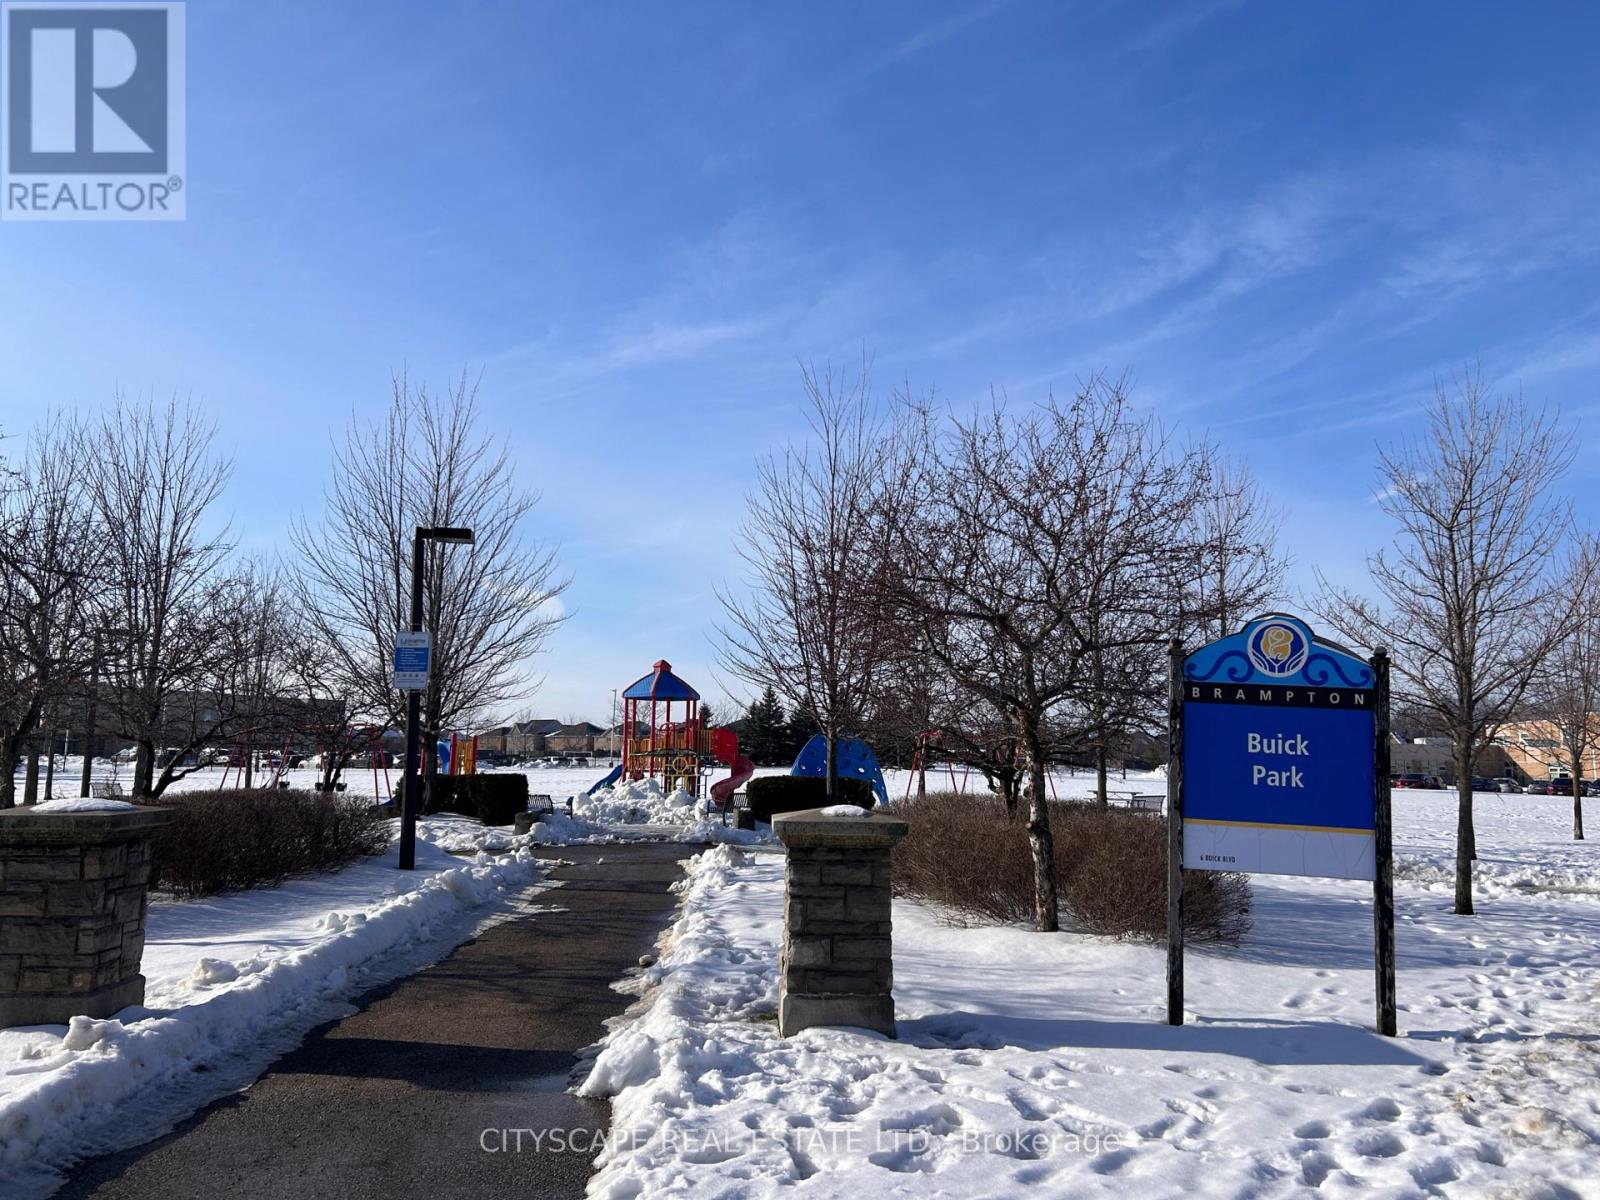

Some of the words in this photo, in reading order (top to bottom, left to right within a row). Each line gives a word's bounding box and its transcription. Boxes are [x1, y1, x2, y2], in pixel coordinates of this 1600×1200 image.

[1192, 686, 1364, 705] BRAMPTON
[1247, 733, 1310, 756] Buick
[1252, 765, 1304, 788] Park
